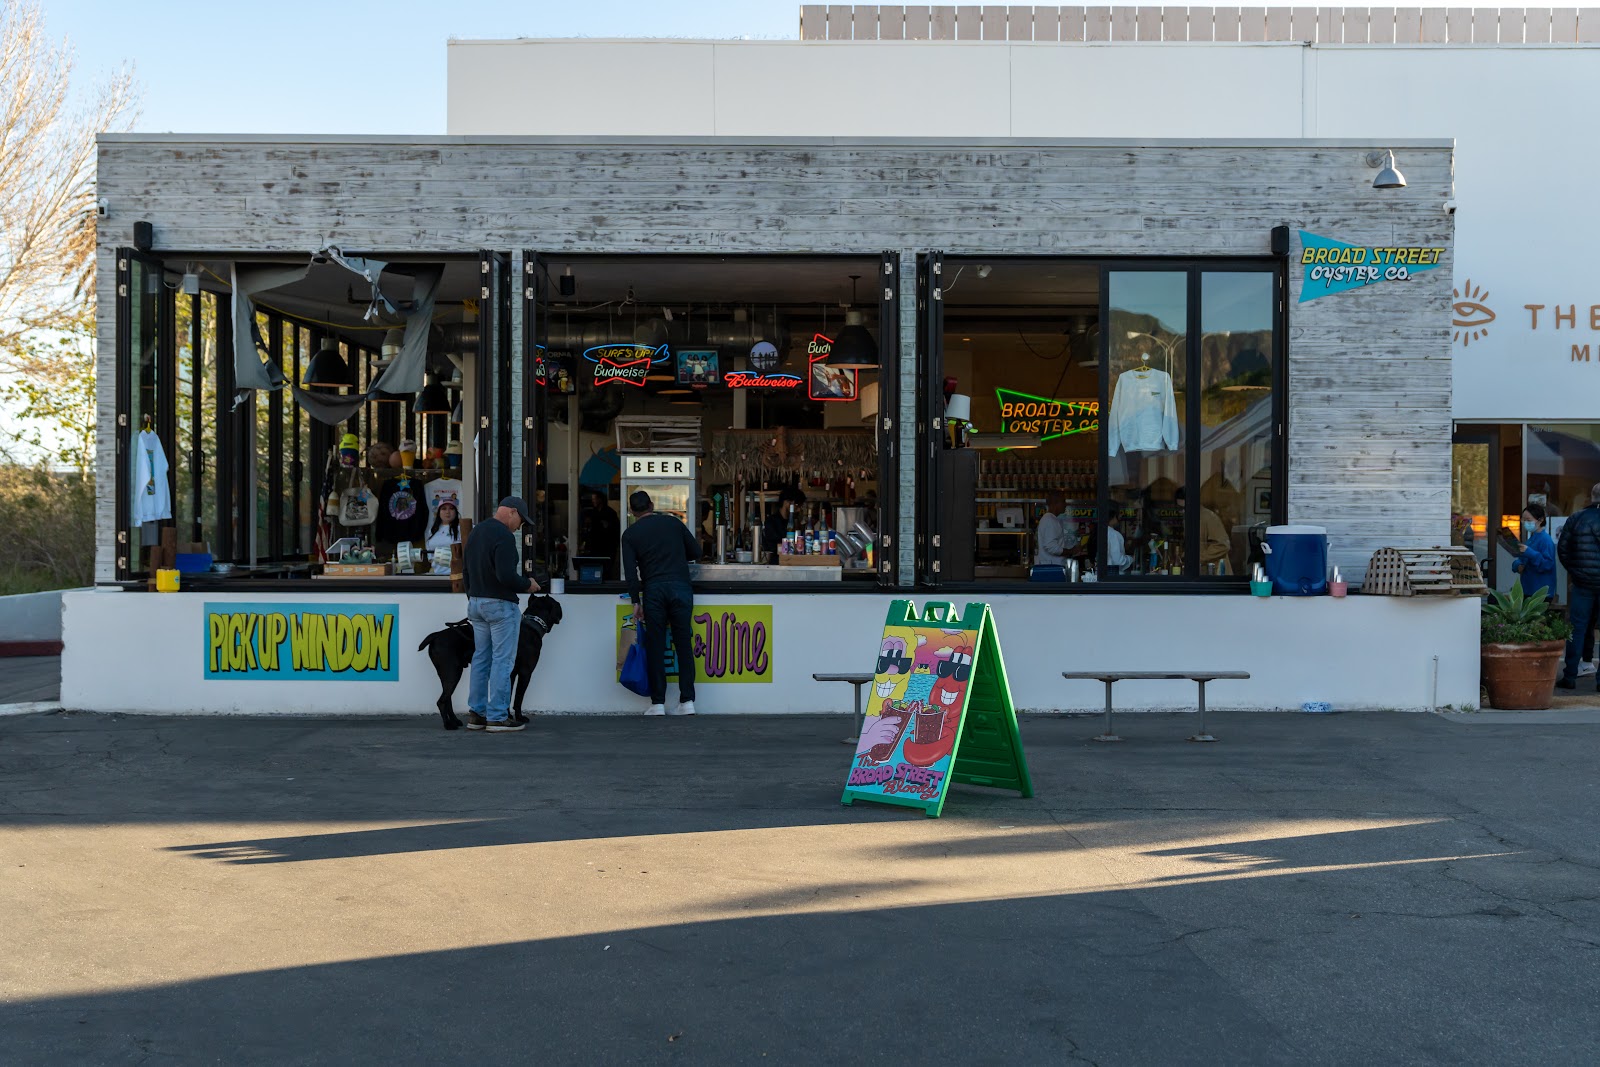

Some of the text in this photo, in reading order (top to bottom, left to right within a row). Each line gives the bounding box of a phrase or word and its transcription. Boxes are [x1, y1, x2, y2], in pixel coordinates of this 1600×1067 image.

[1302, 247, 1446, 264] BROAD STREET
[1310, 265, 1412, 288] OYSTER CO.
[1524, 304, 1600, 331] THE
[597, 348, 633, 359] SURF'S
[1571, 344, 1600, 362] M
[594, 362, 651, 377] Budweiser
[724, 373, 803, 388] Budweiser
[1001, 402, 1062, 418] BROAD
[1010, 419, 1076, 435] OYSTER
[633, 461, 683, 473] BEER
[289, 612, 395, 672] WINDOW
[694, 612, 769, 677] Wine
[857, 752, 880, 767] The
[848, 763, 945, 788] BROAD STREET
[883, 778, 940, 800] Bloody
